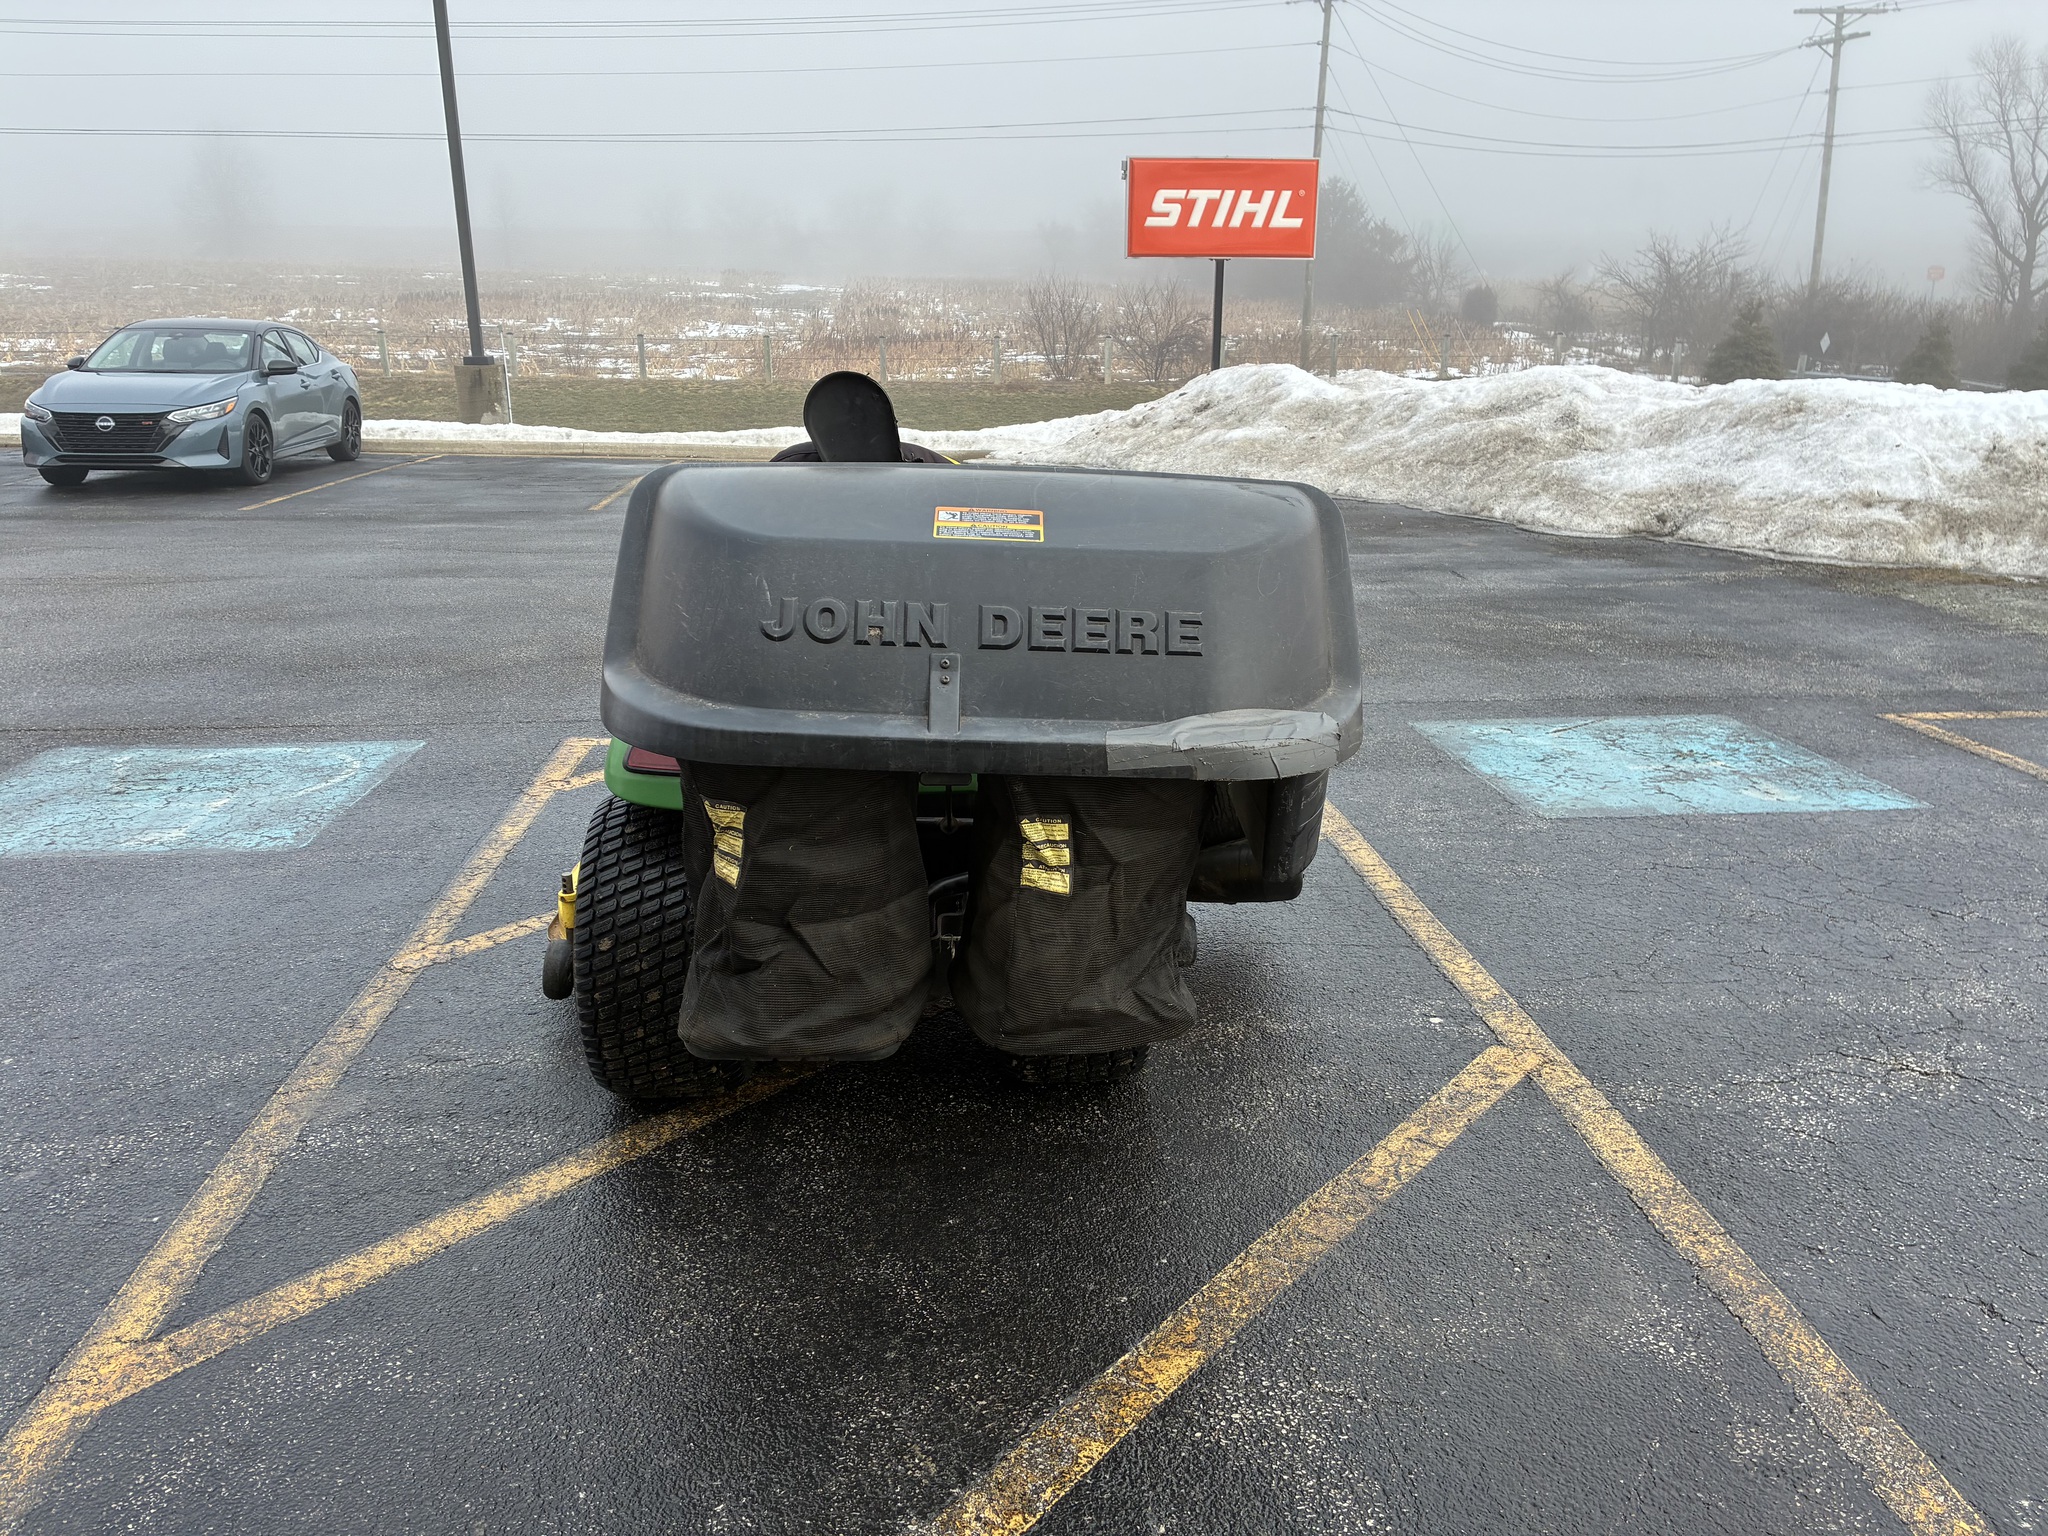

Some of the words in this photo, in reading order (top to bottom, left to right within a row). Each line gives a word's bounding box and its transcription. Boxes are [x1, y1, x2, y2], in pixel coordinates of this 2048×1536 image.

[1144, 189, 1303, 228] STIHL
[758, 596, 949, 649] JOHN
[977, 603, 1204, 657] DEERE
[715, 803, 741, 811] CAUTION
